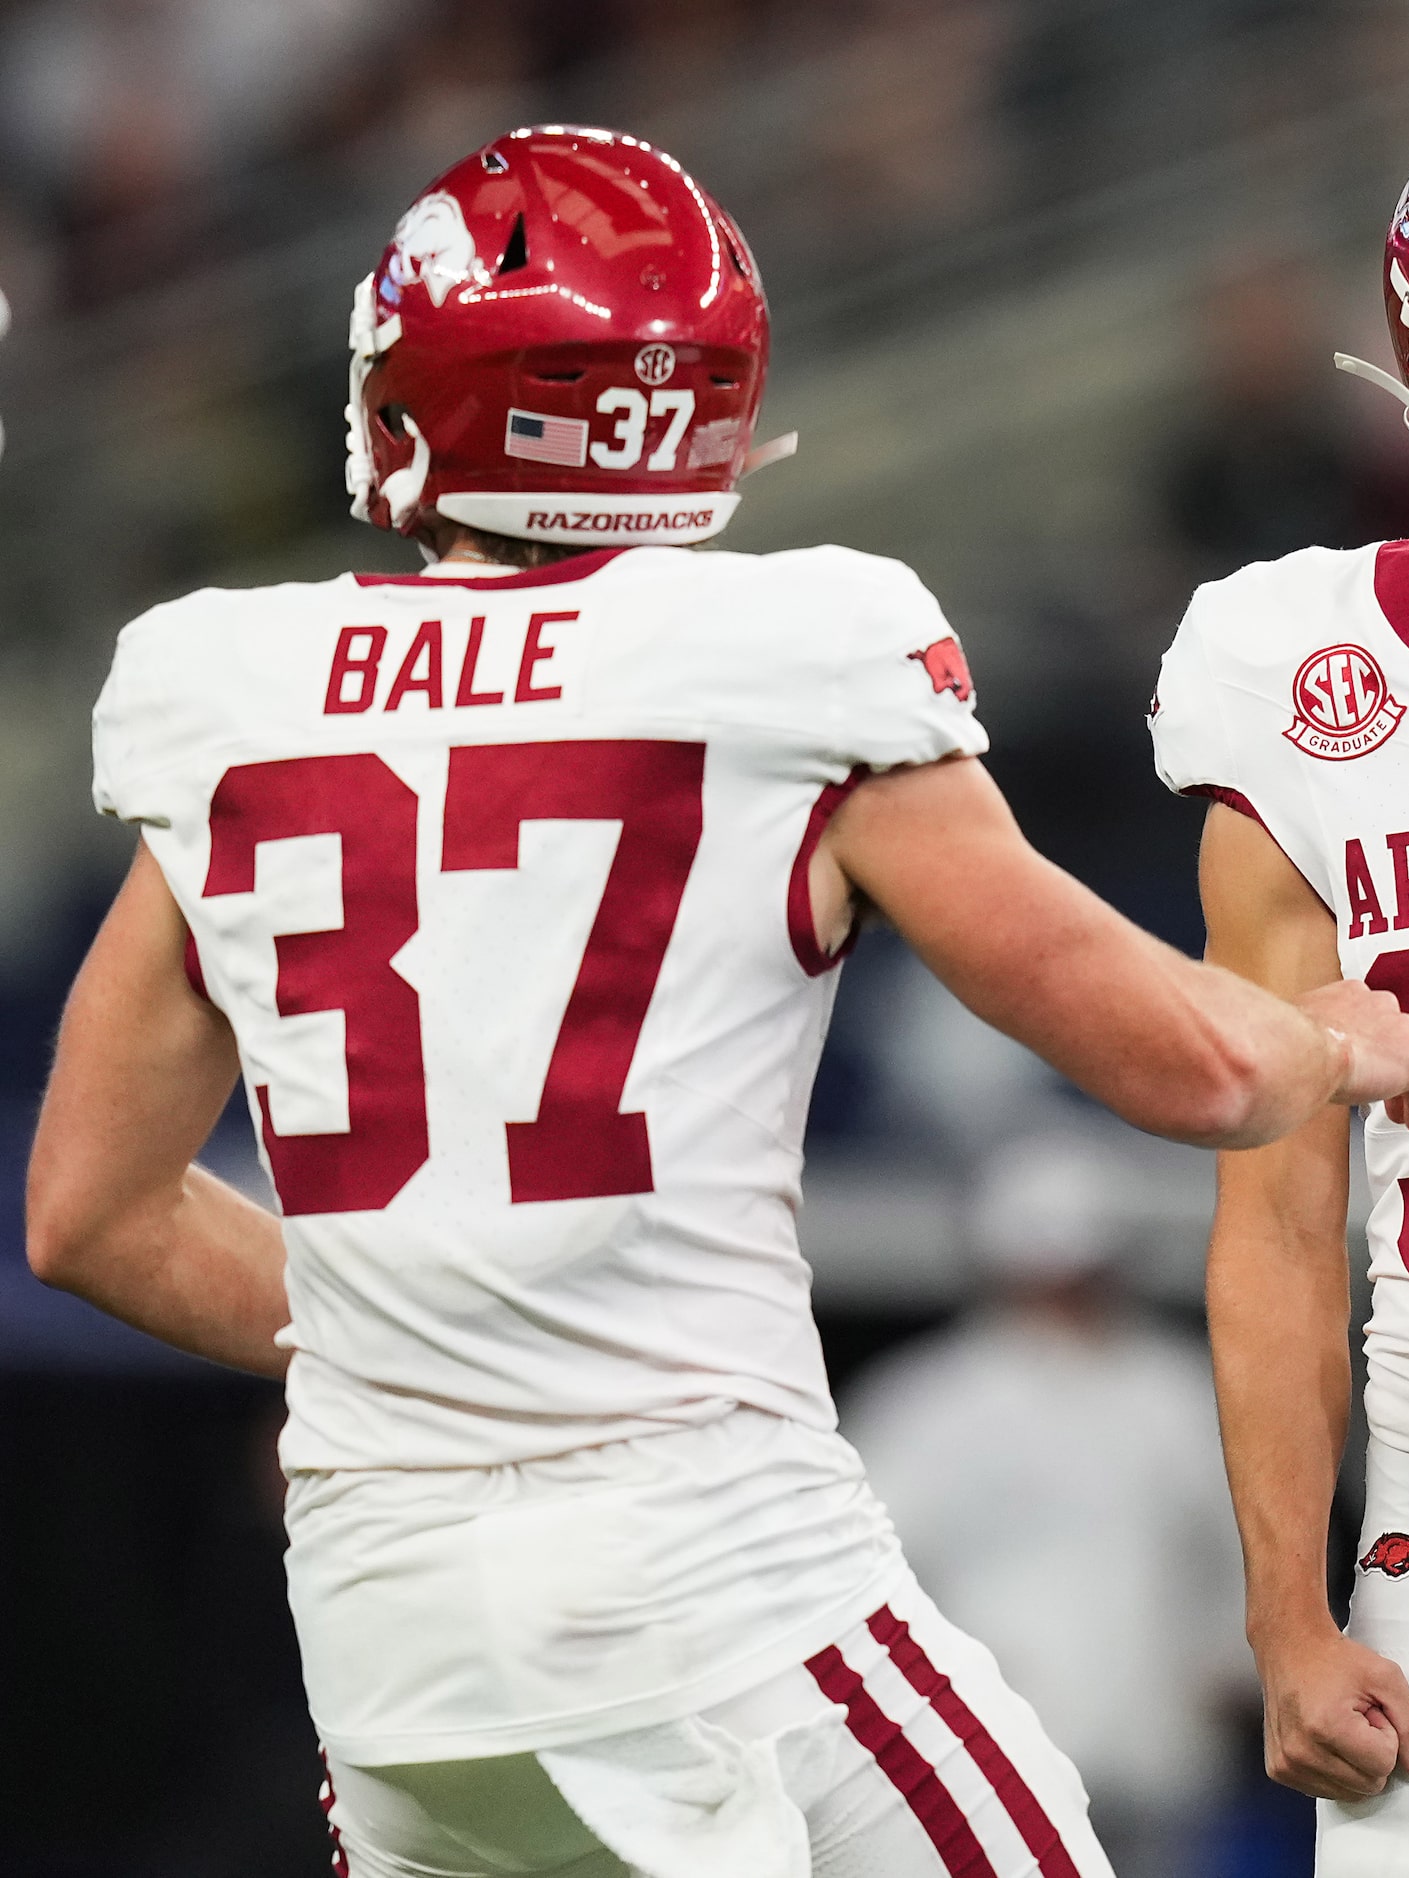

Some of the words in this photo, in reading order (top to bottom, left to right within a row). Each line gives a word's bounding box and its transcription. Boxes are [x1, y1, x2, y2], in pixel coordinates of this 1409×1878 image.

[639, 347, 673, 382] SEC
[589, 386, 696, 471] 37
[526, 509, 714, 533] RAZORBACKS
[323, 610, 580, 716] BALE
[1302, 652, 1377, 730] SEC
[1308, 719, 1388, 753] GRADUATE
[201, 739, 707, 1217] 37
